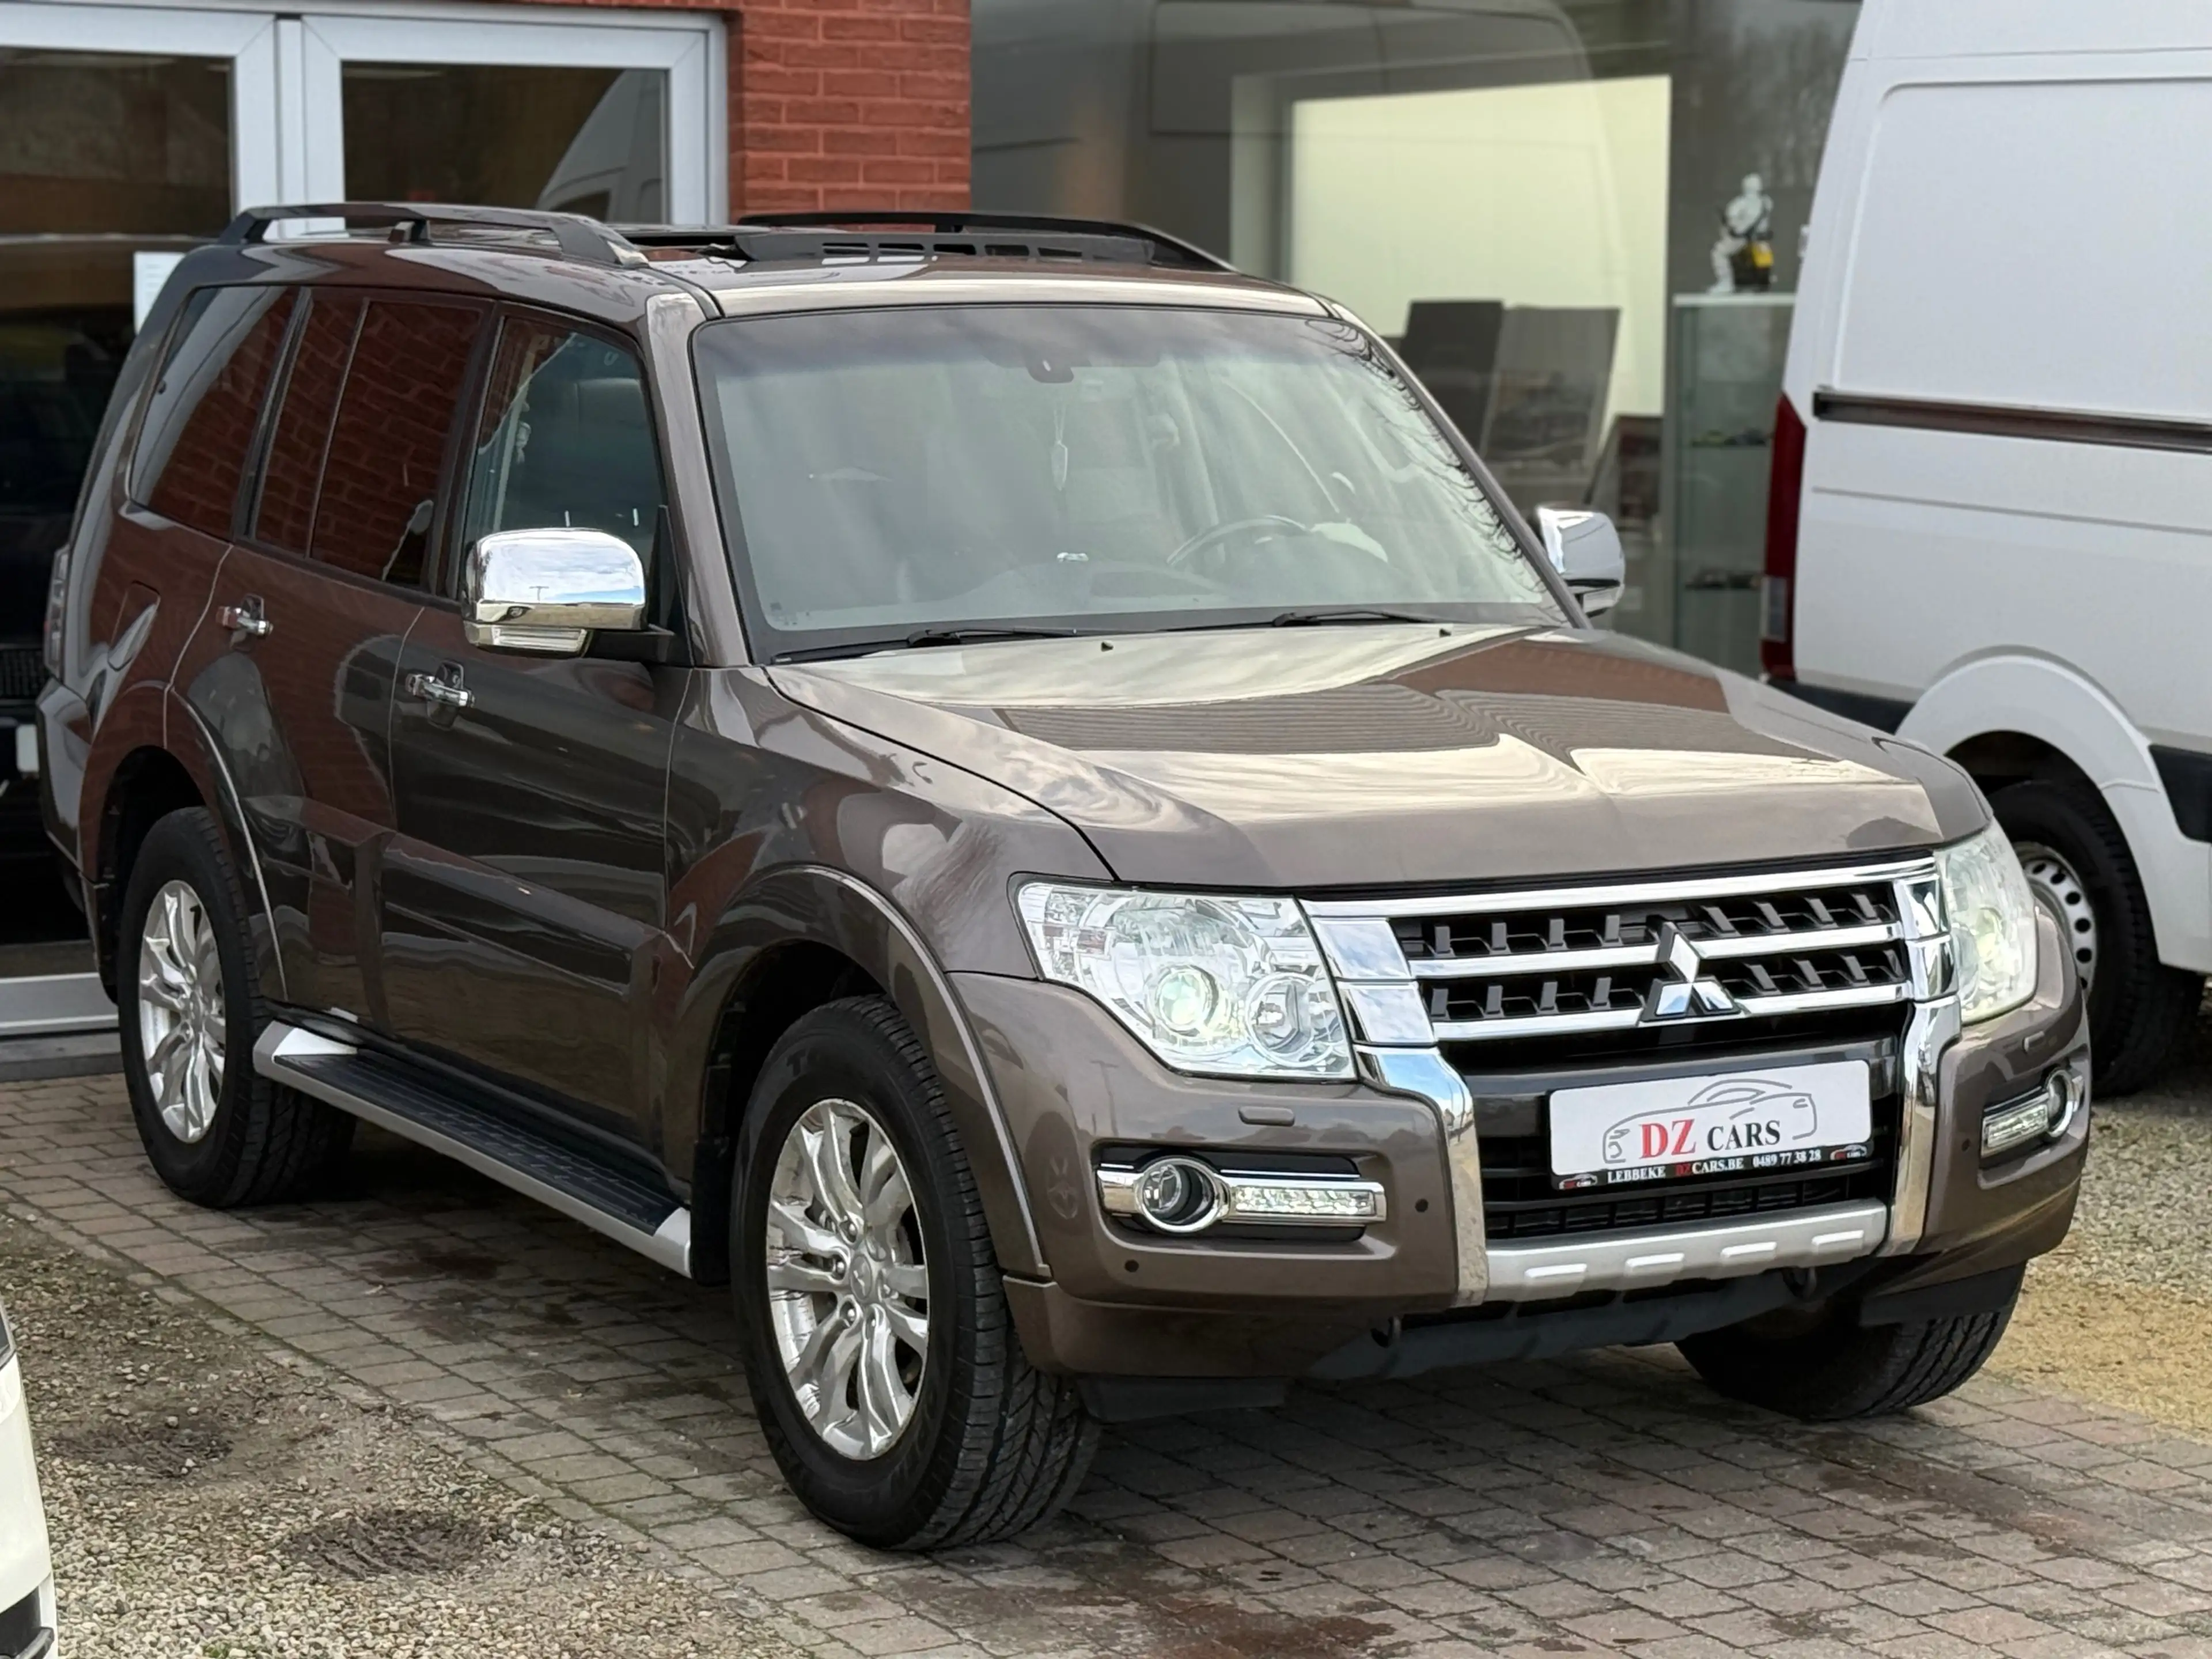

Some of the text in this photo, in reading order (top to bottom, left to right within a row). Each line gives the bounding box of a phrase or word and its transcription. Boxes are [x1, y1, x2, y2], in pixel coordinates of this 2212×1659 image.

[1639, 1119, 1781, 1160] DZ CARS
[1607, 1165, 1666, 1183] LEBBEKE
[1675, 1157, 1744, 1176] DZCARS.BE
[1752, 1154, 1778, 1168] 0489
[1779, 1152, 1792, 1165] 77
[1808, 1149, 1821, 1162] 28
